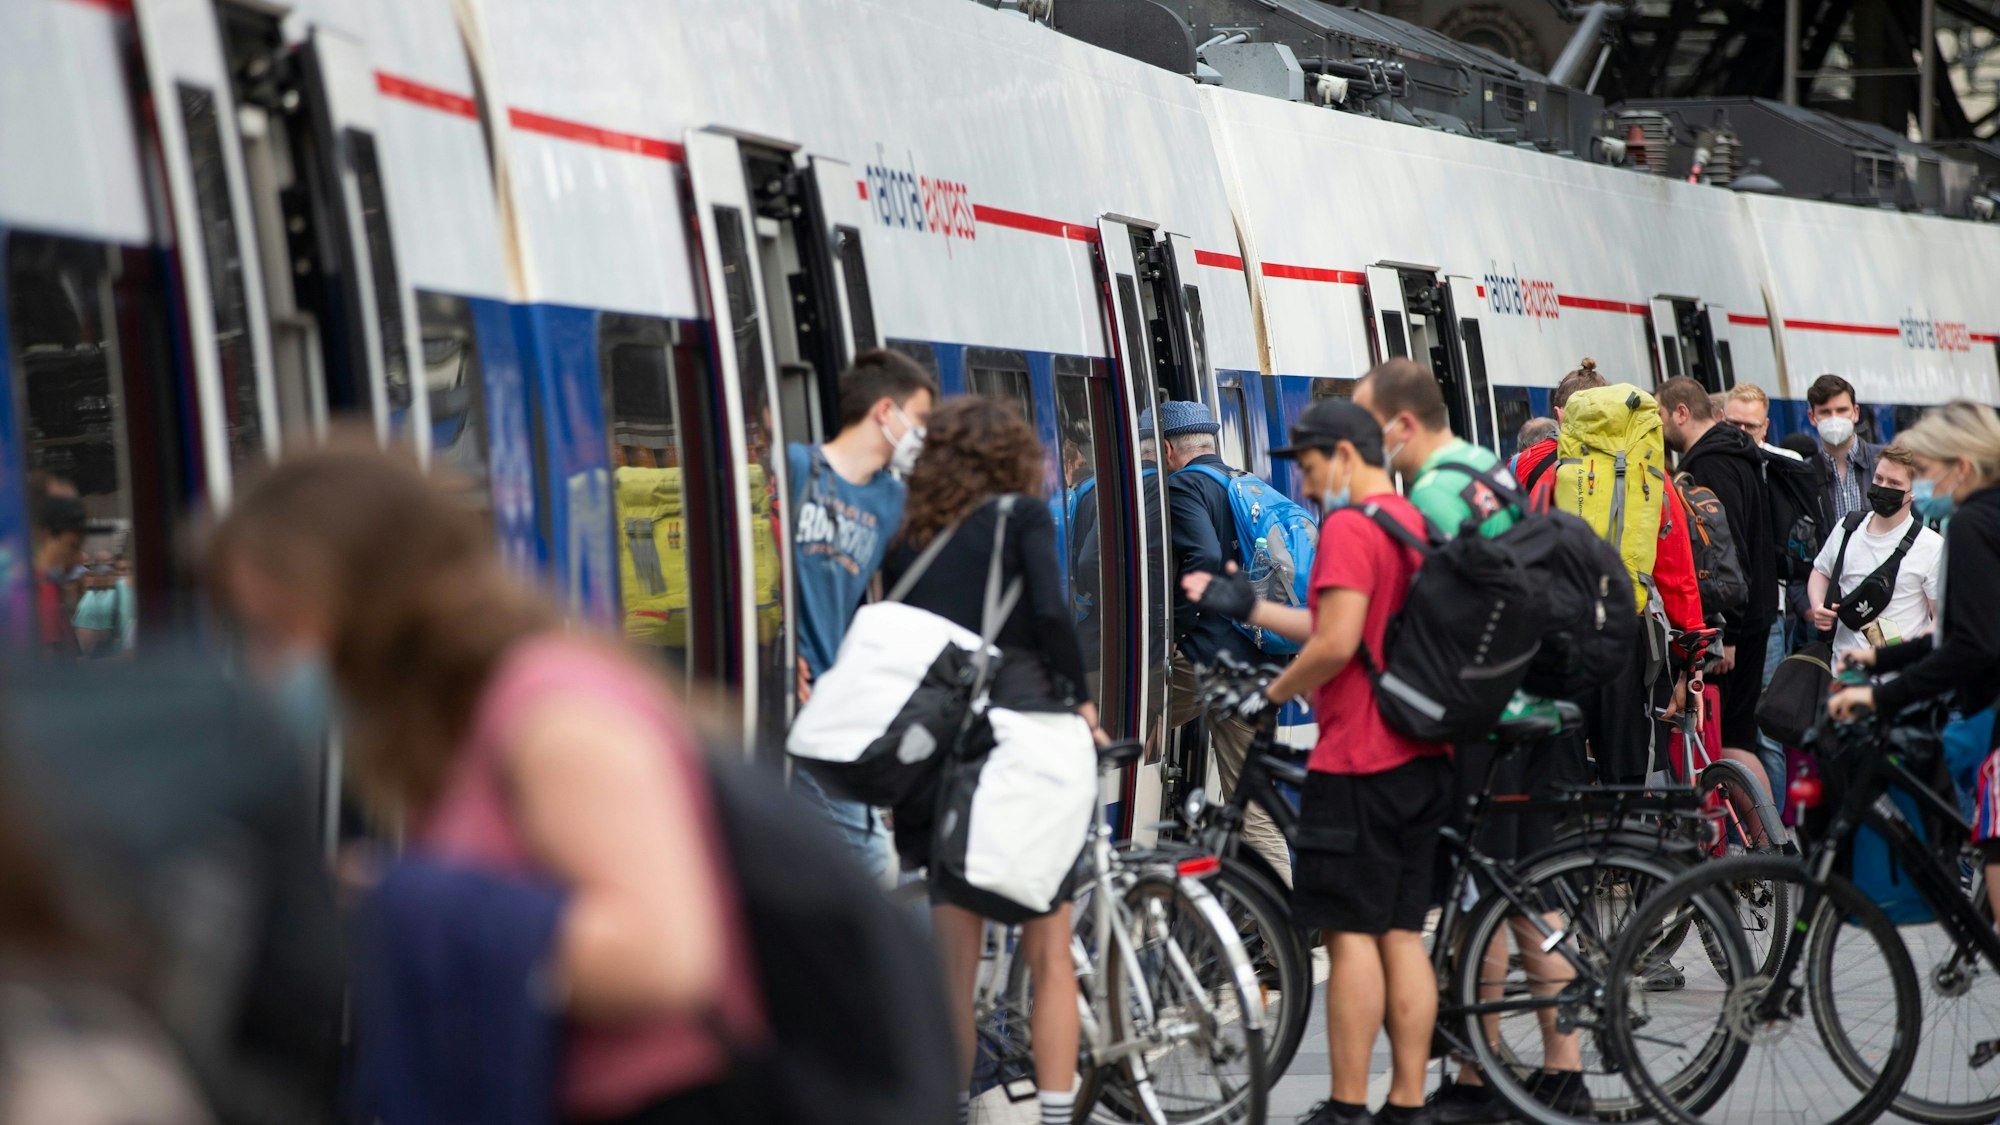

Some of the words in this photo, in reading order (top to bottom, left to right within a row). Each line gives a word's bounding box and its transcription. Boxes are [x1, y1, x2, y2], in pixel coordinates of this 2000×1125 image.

[866, 142, 927, 232] national
[920, 175, 976, 261] express
[1484, 259, 1524, 315] national
[1521, 279, 1560, 334] express
[1900, 305, 1935, 351] national
[1934, 320, 1970, 364] express
